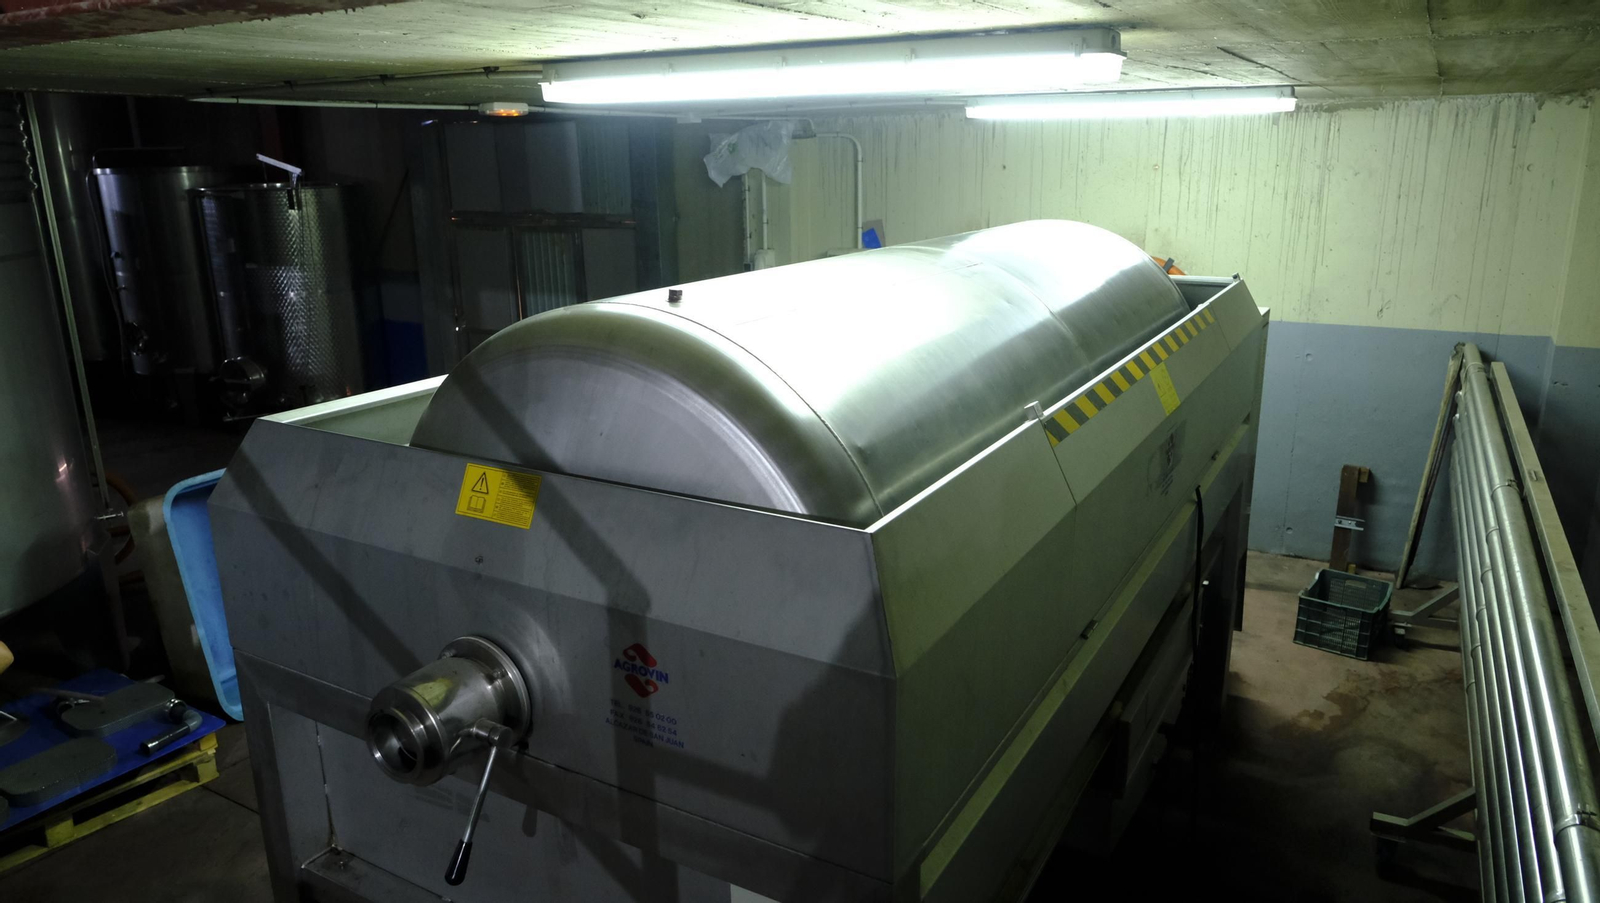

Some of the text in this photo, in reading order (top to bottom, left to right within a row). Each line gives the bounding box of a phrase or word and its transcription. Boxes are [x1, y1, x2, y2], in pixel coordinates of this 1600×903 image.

[614, 658, 669, 684] AGROVIN
[655, 713, 665, 722] 02
[666, 716, 677, 726] 00
[667, 728, 677, 736] 54
[649, 731, 664, 742] SAN
[665, 737, 684, 749] JUAN
